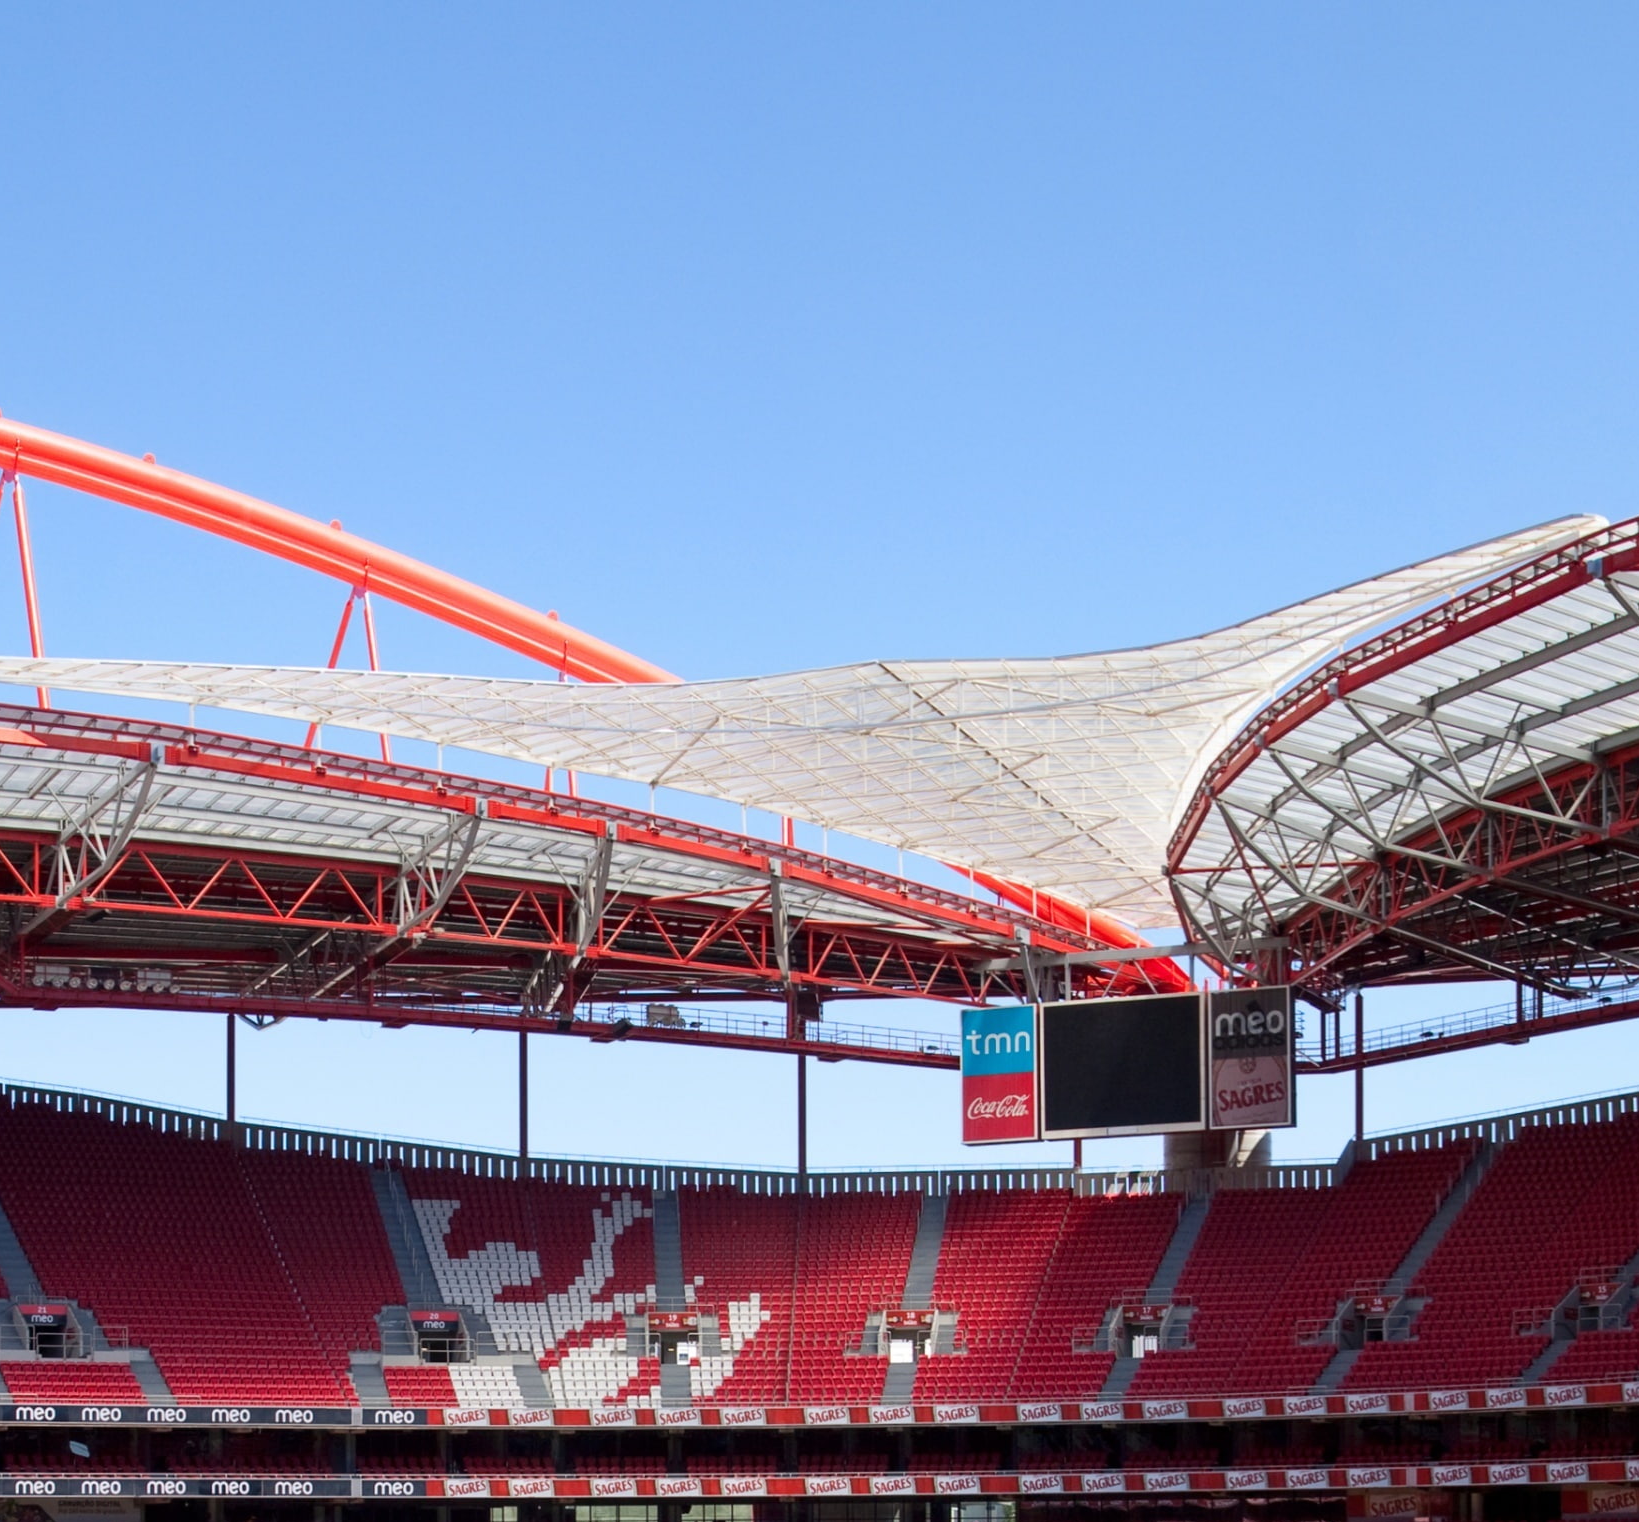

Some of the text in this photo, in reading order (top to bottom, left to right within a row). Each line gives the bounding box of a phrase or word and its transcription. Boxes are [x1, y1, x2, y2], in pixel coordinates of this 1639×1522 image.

[1215, 1010, 1285, 1037] meo
[966, 1029, 1030, 1055] tmn
[967, 1094, 1030, 1120] Coca-Cola
[1217, 1082, 1285, 1113] SAGRES
[1488, 1388, 1525, 1406] SAGRES
[448, 1409, 485, 1425] SAGRES
[1085, 1474, 1121, 1492] SAGRES
[1370, 1496, 1417, 1516] SAGRES
[1593, 1493, 1637, 1514] SAGRES
